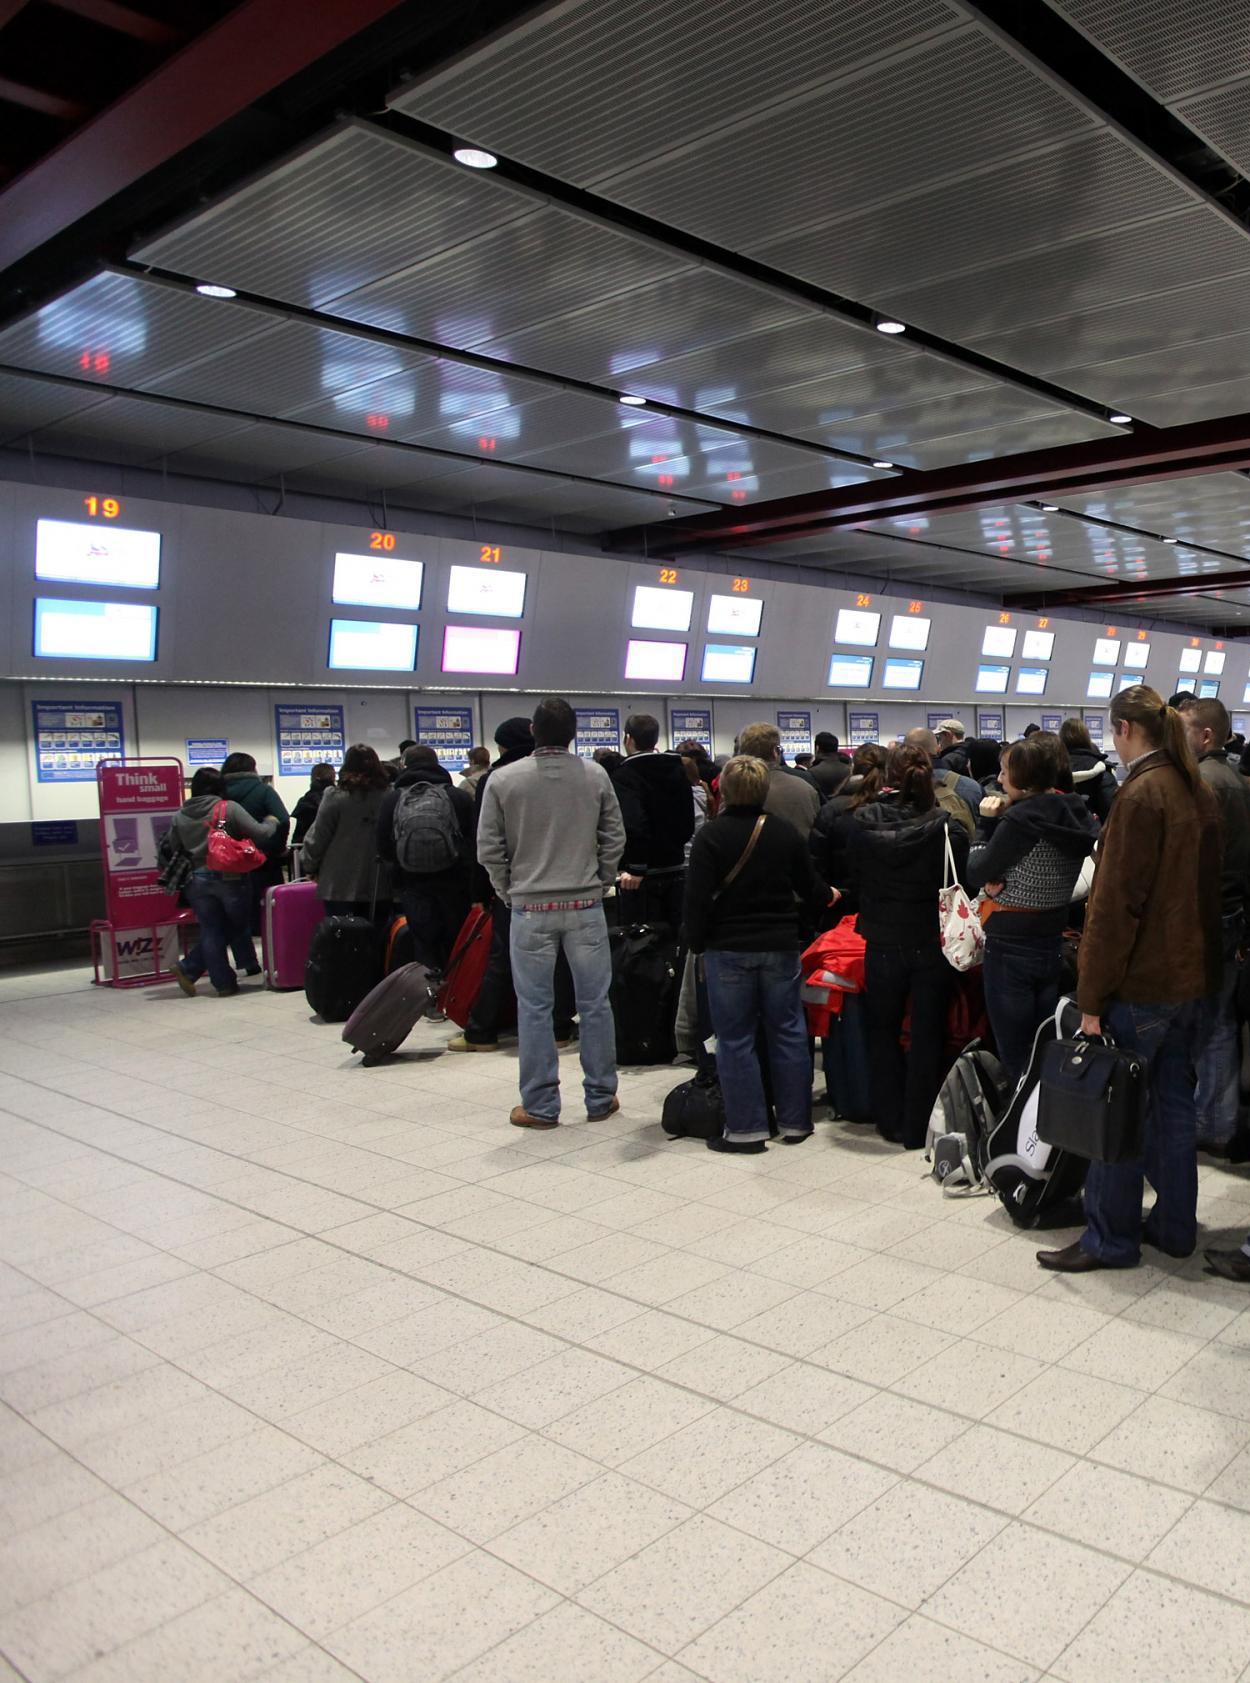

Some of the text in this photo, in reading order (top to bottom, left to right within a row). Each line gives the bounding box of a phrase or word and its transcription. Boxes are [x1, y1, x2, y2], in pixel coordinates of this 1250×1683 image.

[83, 496, 119, 518] 19
[369, 532, 396, 551] 20
[480, 546, 500, 563] 21
[660, 569, 677, 584] 22
[732, 579, 749, 592] 23
[856, 594, 870, 608] 24
[115, 773, 158, 786] Think
[139, 784, 167, 793] small
